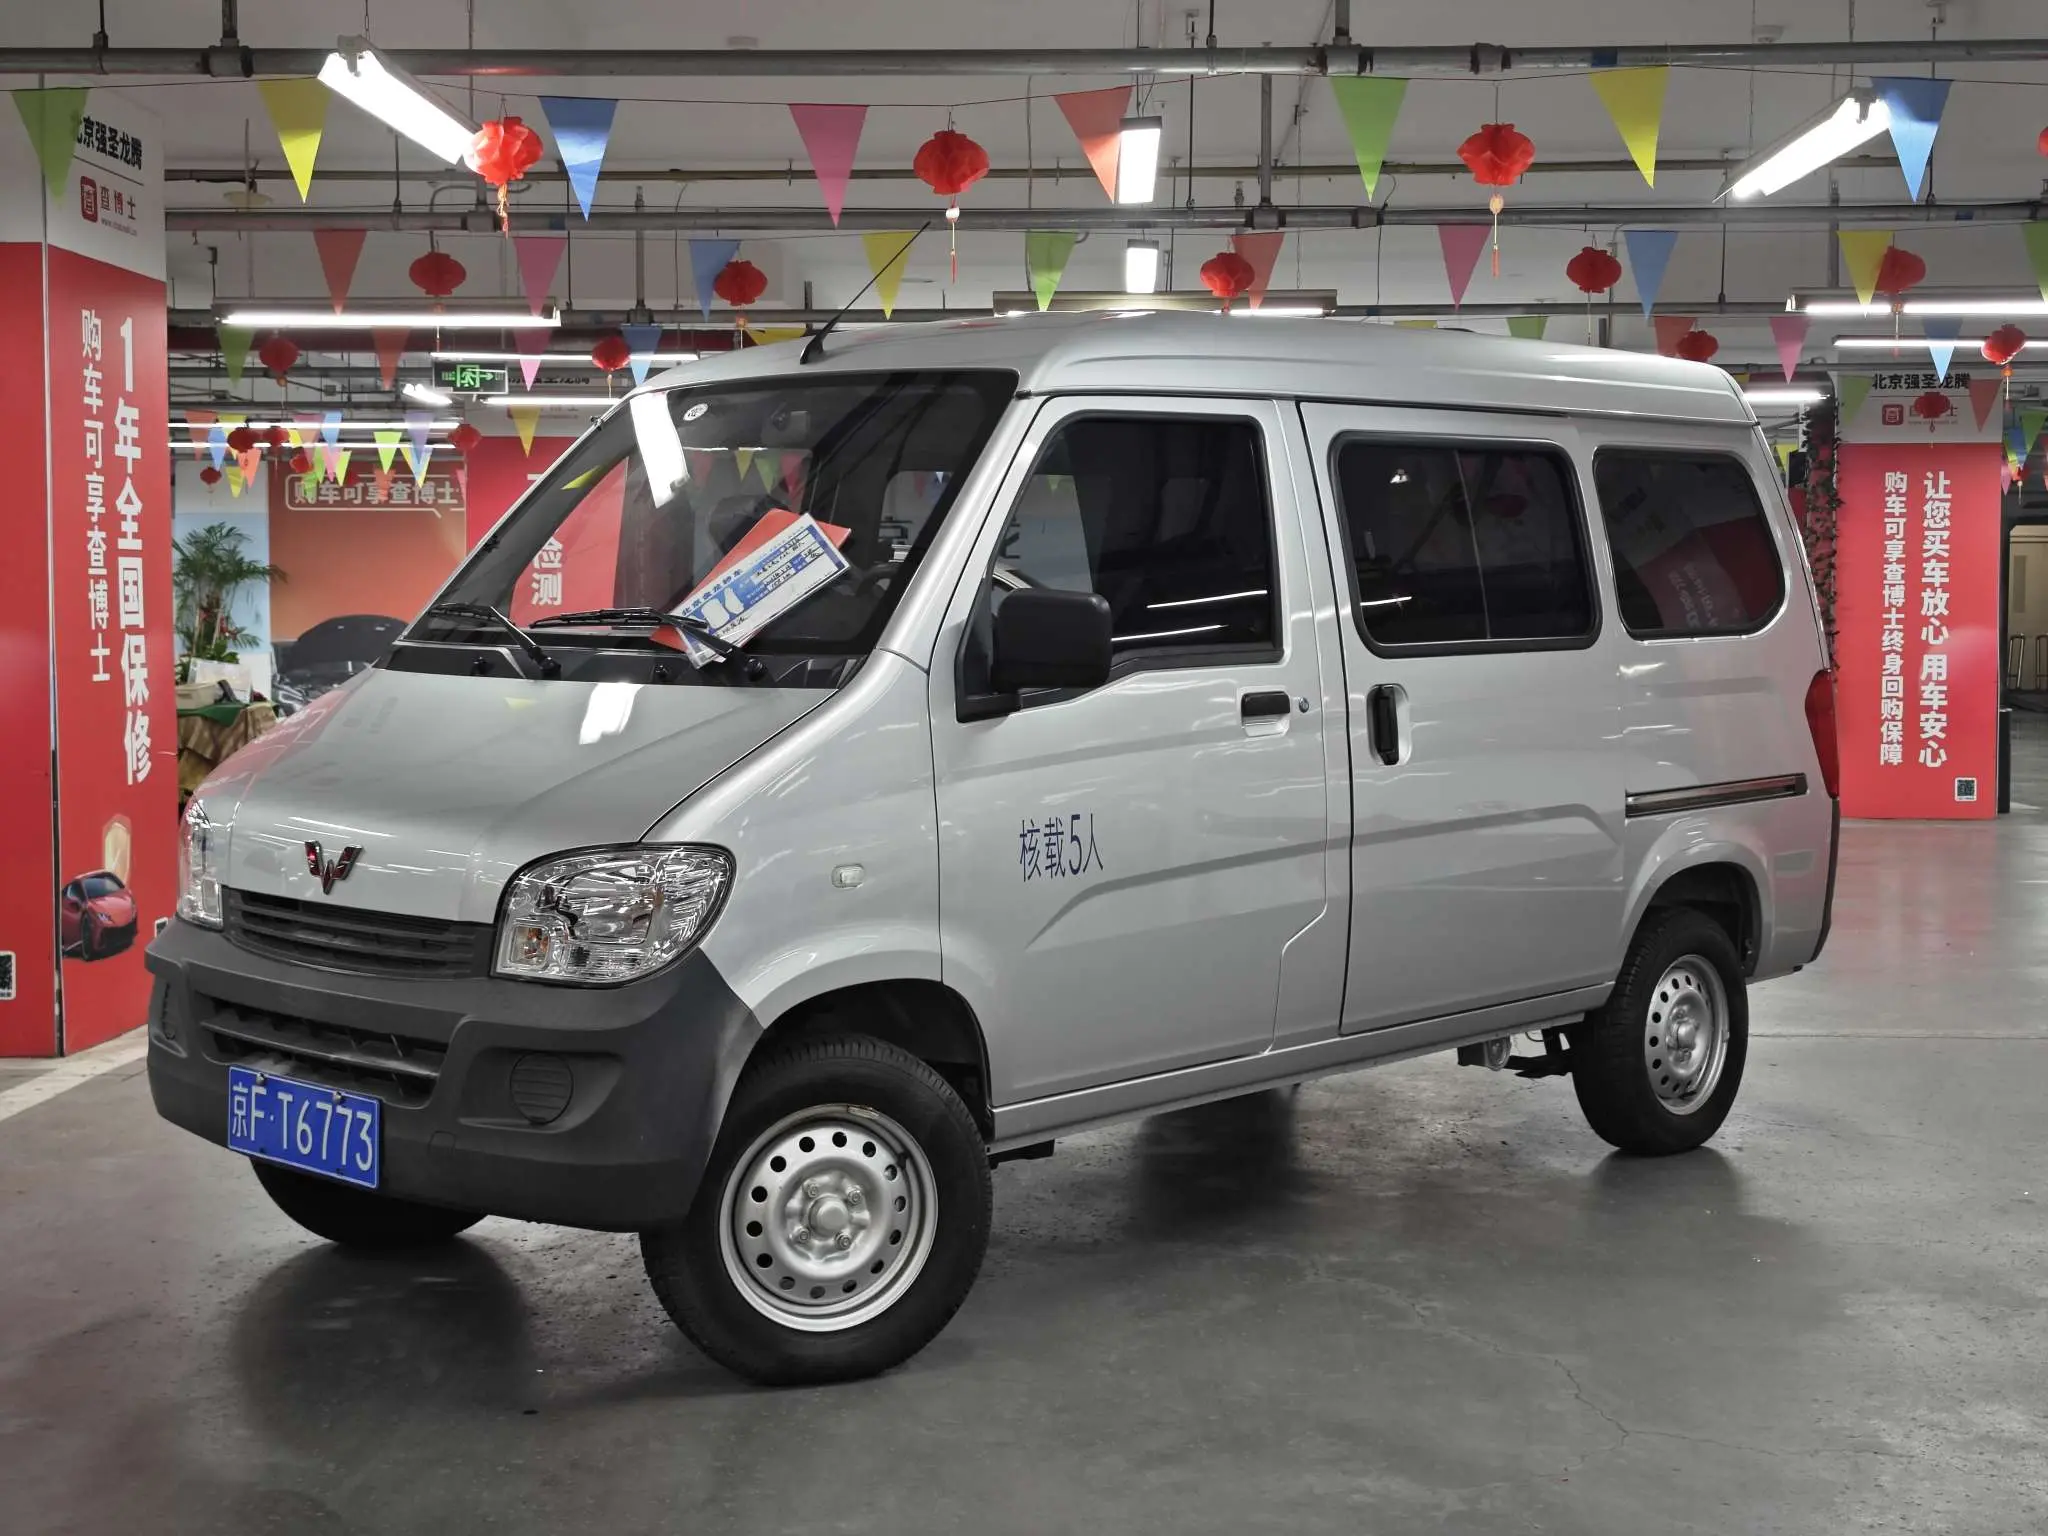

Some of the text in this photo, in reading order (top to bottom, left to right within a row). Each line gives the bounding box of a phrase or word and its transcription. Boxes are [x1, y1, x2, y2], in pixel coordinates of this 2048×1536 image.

[82, 309, 111, 682] 购车可享查博士
[1872, 373, 1970, 390] 北京强圣龙腾
[114, 317, 152, 785] 1年全国保修
[1880, 471, 1908, 766] 购车可享查博士终身回购保障
[1918, 471, 1952, 768] 让您买车放心 用车安心
[1019, 813, 1103, 882] 核载5人
[232, 1081, 373, 1172] 京F·T6773
